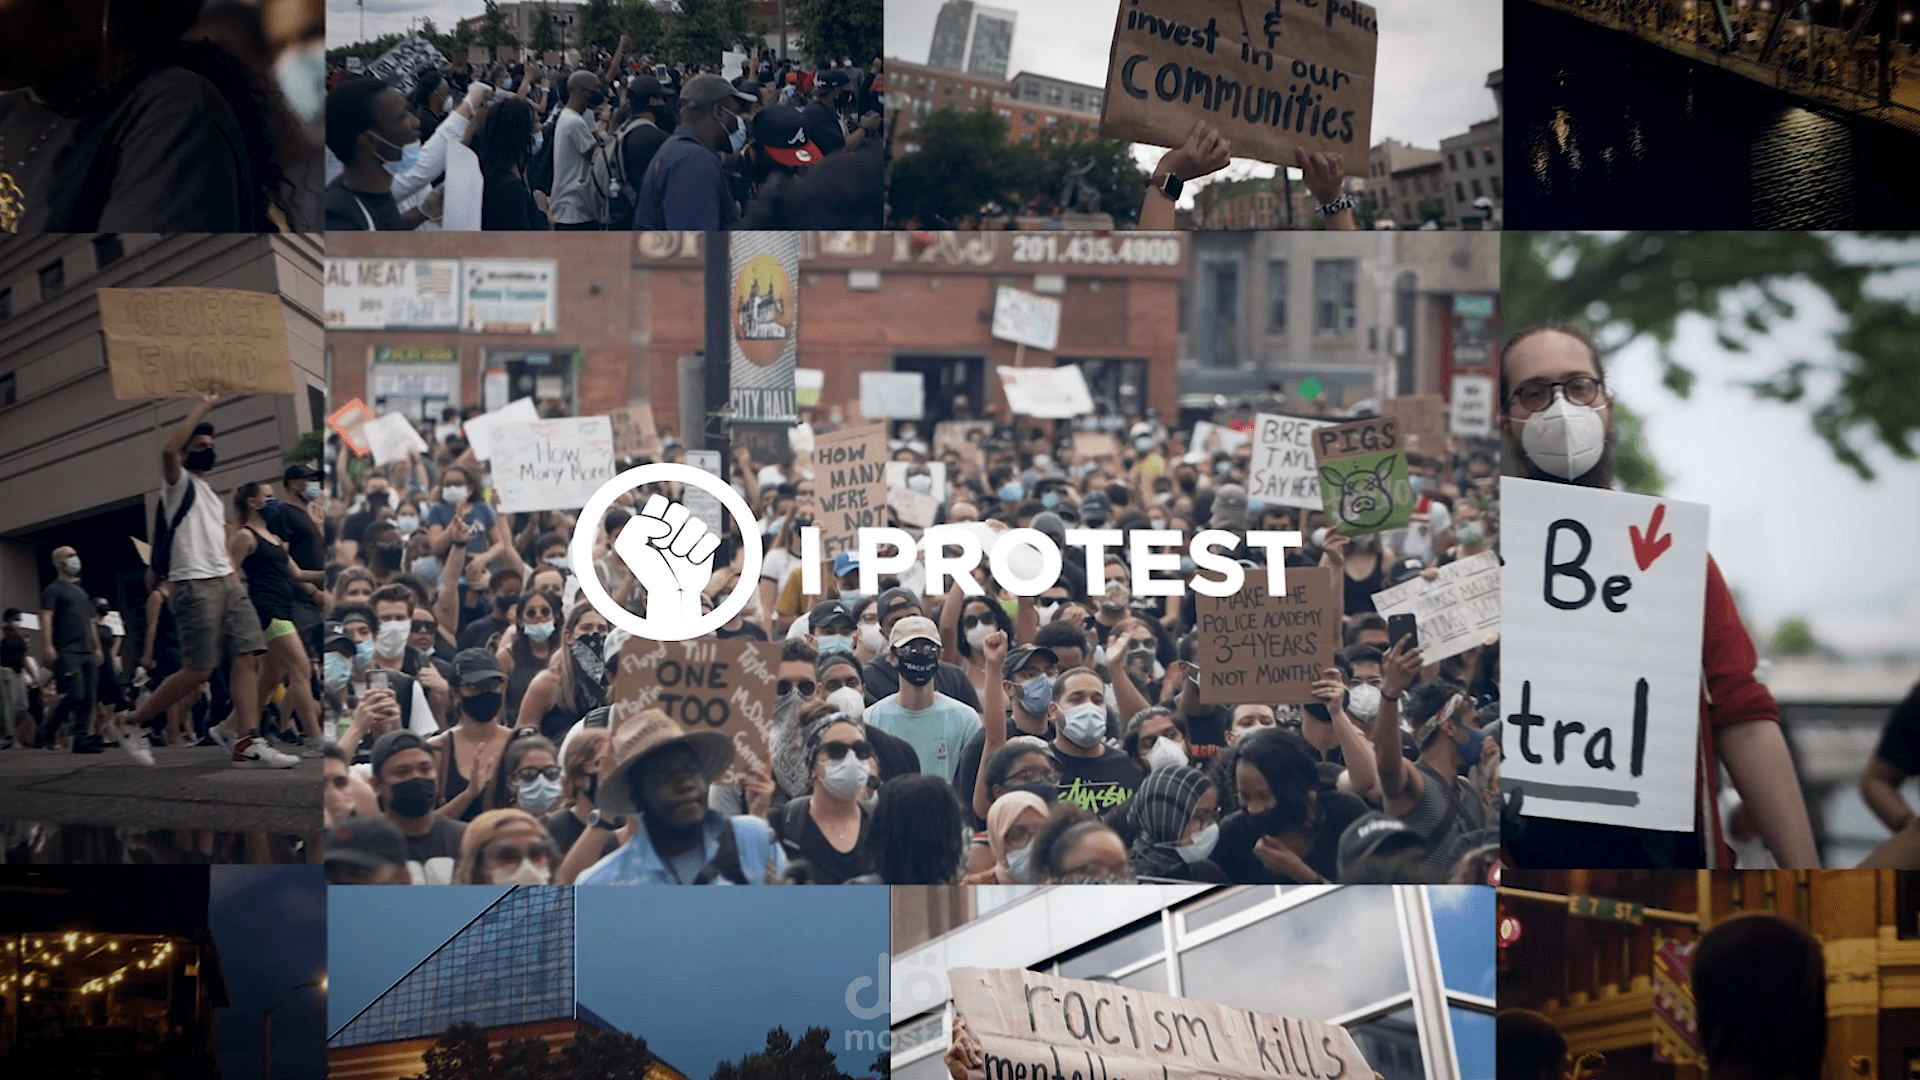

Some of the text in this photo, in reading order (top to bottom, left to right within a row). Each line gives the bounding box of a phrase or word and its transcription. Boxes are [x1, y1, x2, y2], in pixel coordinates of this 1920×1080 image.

[1128, 9, 1350, 92] invest in our
[1121, 53, 1355, 144] Communities
[357, 260, 408, 288] MEAT
[125, 290, 272, 339] GEORGE
[136, 340, 263, 394] FLOYD
[730, 389, 797, 420] CITY HALL
[535, 440, 581, 464] How
[818, 443, 867, 465] HOW
[1318, 422, 1397, 457] PIGS
[519, 462, 565, 485] Many
[829, 461, 887, 490] MANY
[1251, 469, 1289, 497] SAY
[819, 488, 869, 513] WERE
[843, 503, 886, 531] NOT
[1543, 518, 1633, 613] Be
[1214, 585, 1265, 612] MAKE
[1202, 608, 1324, 634] POLICE ACADEMY
[680, 640, 718, 662] Till
[736, 641, 777, 685] Taylor
[655, 659, 730, 689] ONE
[1211, 662, 1323, 687] NOT MONTHS
[657, 692, 731, 728] TOO
[1500, 676, 1650, 778] tral
[1568, 895, 1633, 920] E 7 ST
[1023, 982, 1347, 1080] racism kills
[984, 1045, 1127, 1080] mentall
